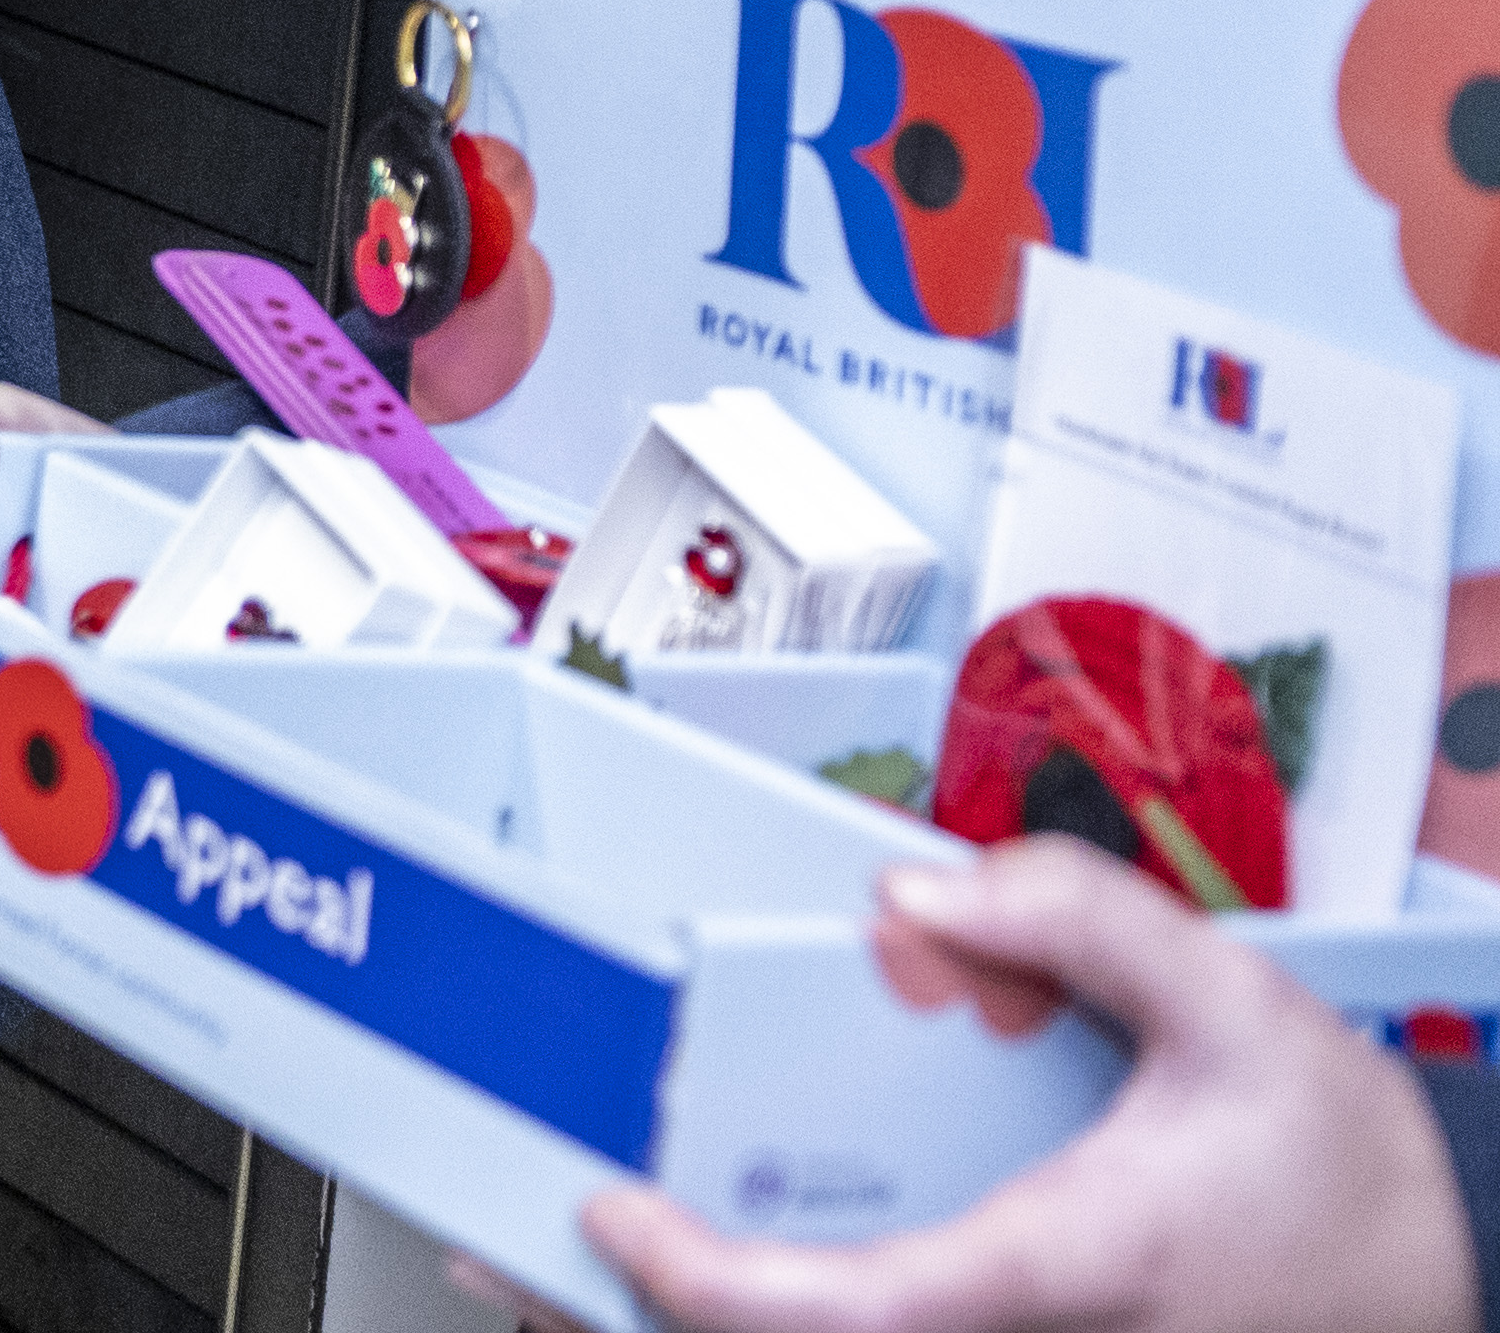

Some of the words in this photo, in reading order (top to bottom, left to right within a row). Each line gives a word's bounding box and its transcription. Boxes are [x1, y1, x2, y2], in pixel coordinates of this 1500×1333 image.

[697, 303, 822, 378] ROYAL
[838, 347, 1012, 434] BRITISH
[127, 769, 374, 966] Appeal
